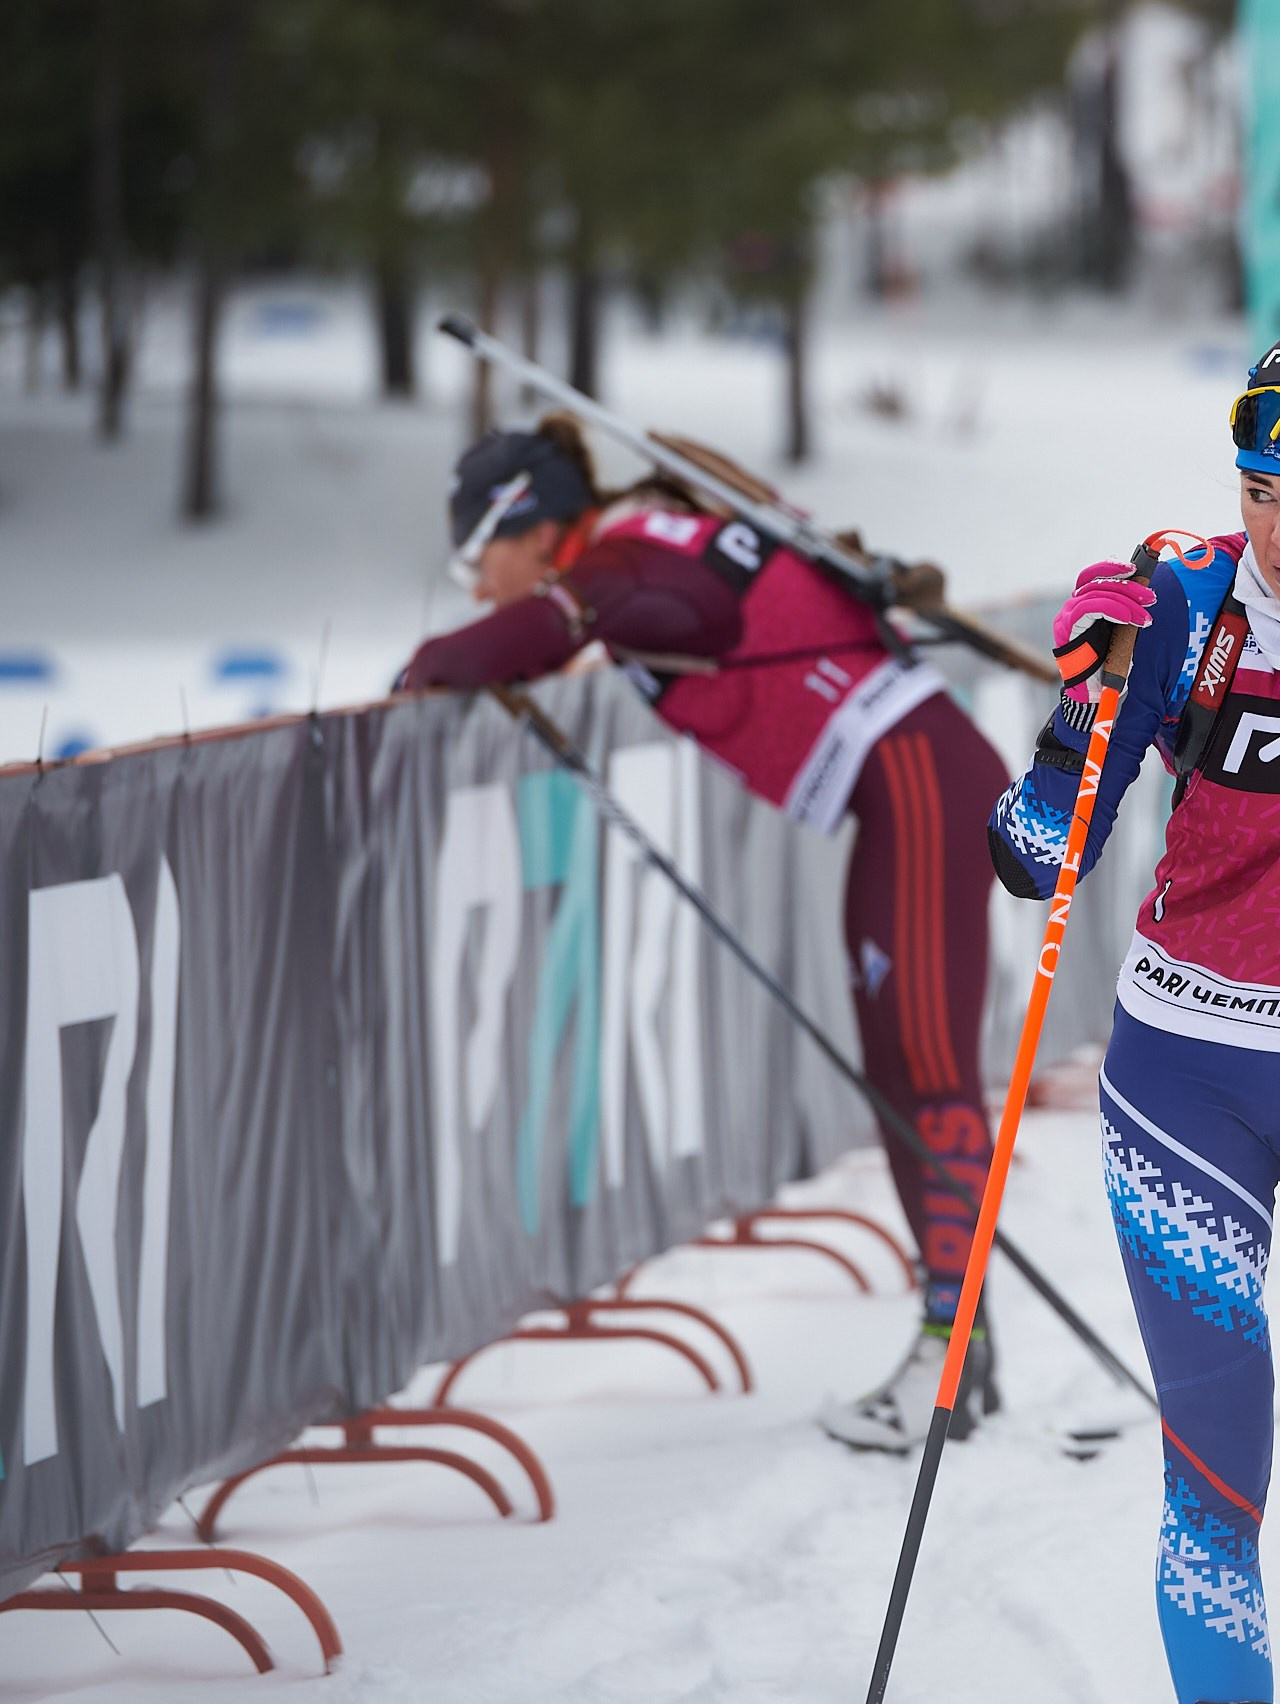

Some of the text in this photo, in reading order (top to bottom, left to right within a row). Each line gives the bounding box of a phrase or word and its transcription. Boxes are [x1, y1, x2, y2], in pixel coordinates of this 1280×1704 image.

[803, 656, 852, 701] 11
[432, 738, 703, 1269] PARI
[1134, 956, 1192, 998] PARI
[22, 852, 180, 1467] RI
